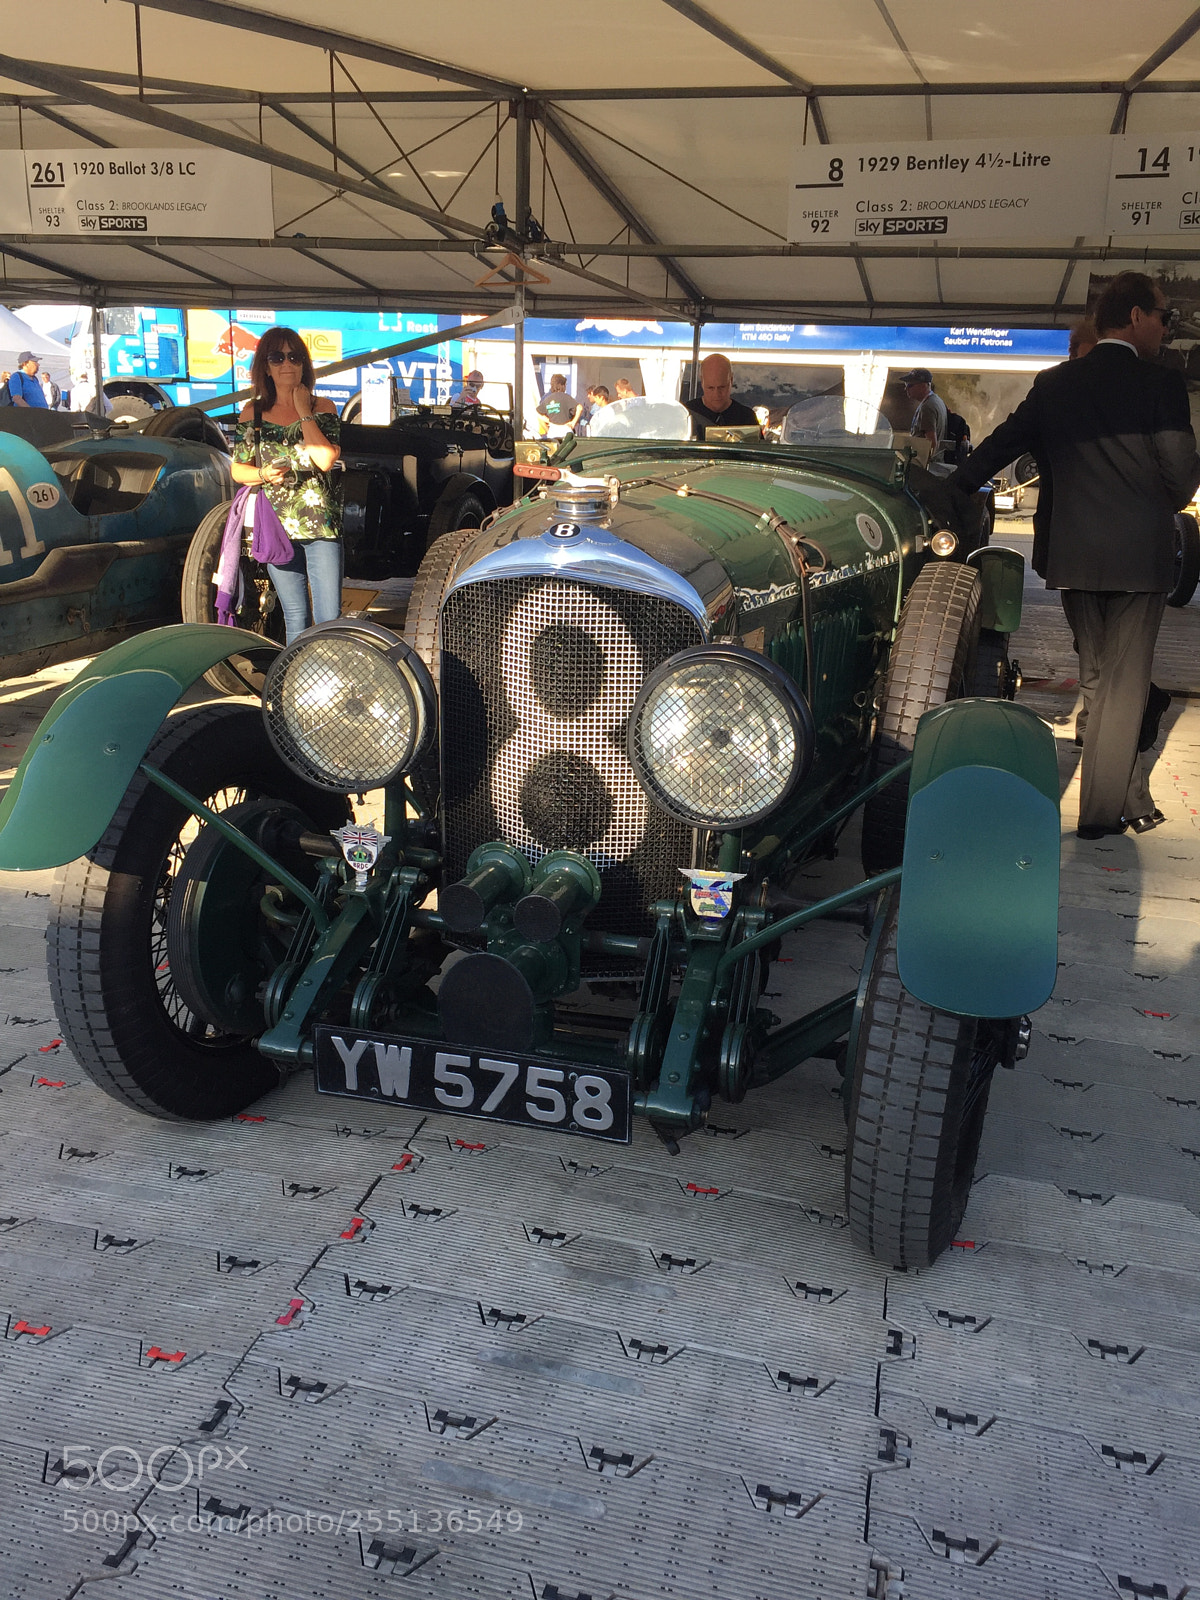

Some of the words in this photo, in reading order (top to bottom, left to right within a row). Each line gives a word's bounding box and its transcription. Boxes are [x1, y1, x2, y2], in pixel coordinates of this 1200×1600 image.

[857, 156, 900, 173] 1929
[906, 154, 970, 173] Bentley
[1138, 147, 1170, 172] 14
[31, 162, 65, 183] 261
[73, 162, 104, 175] 1920
[109, 161, 146, 175] Ballot
[150, 161, 174, 177] 3/8
[179, 162, 196, 175] LC
[828, 158, 844, 182] 8
[856, 200, 894, 213] Class
[899, 200, 913, 212] 2:
[916, 198, 986, 211] BROOKLANDS
[989, 197, 1029, 210] LEGACY
[1182, 191, 1200, 205] Cl
[76, 200, 105, 211] Class
[108, 201, 120, 211] 2:
[121, 201, 174, 212] BROOKLANDS
[176, 202, 207, 212] LEGACY
[1121, 202, 1162, 210] SHELTER
[45, 215, 61, 227] 93
[802, 209, 839, 219] SHELTER
[1131, 211, 1150, 225] 91
[80, 216, 97, 230] sky
[101, 217, 145, 229] SPORTS
[810, 219, 830, 233] 92
[858, 218, 881, 235] sky
[885, 218, 945, 232] SPORTS
[950, 327, 964, 335] Karl
[966, 327, 1009, 337] Wendlinger
[944, 337, 970, 345] Sauber
[980, 338, 1013, 346] Petronas
[33, 488, 55, 504] 261
[555, 523, 575, 537] B
[864, 521, 875, 539] 8
[490, 583, 648, 871] 8
[330, 1036, 413, 1099] YW
[434, 1051, 614, 1131] 5758
